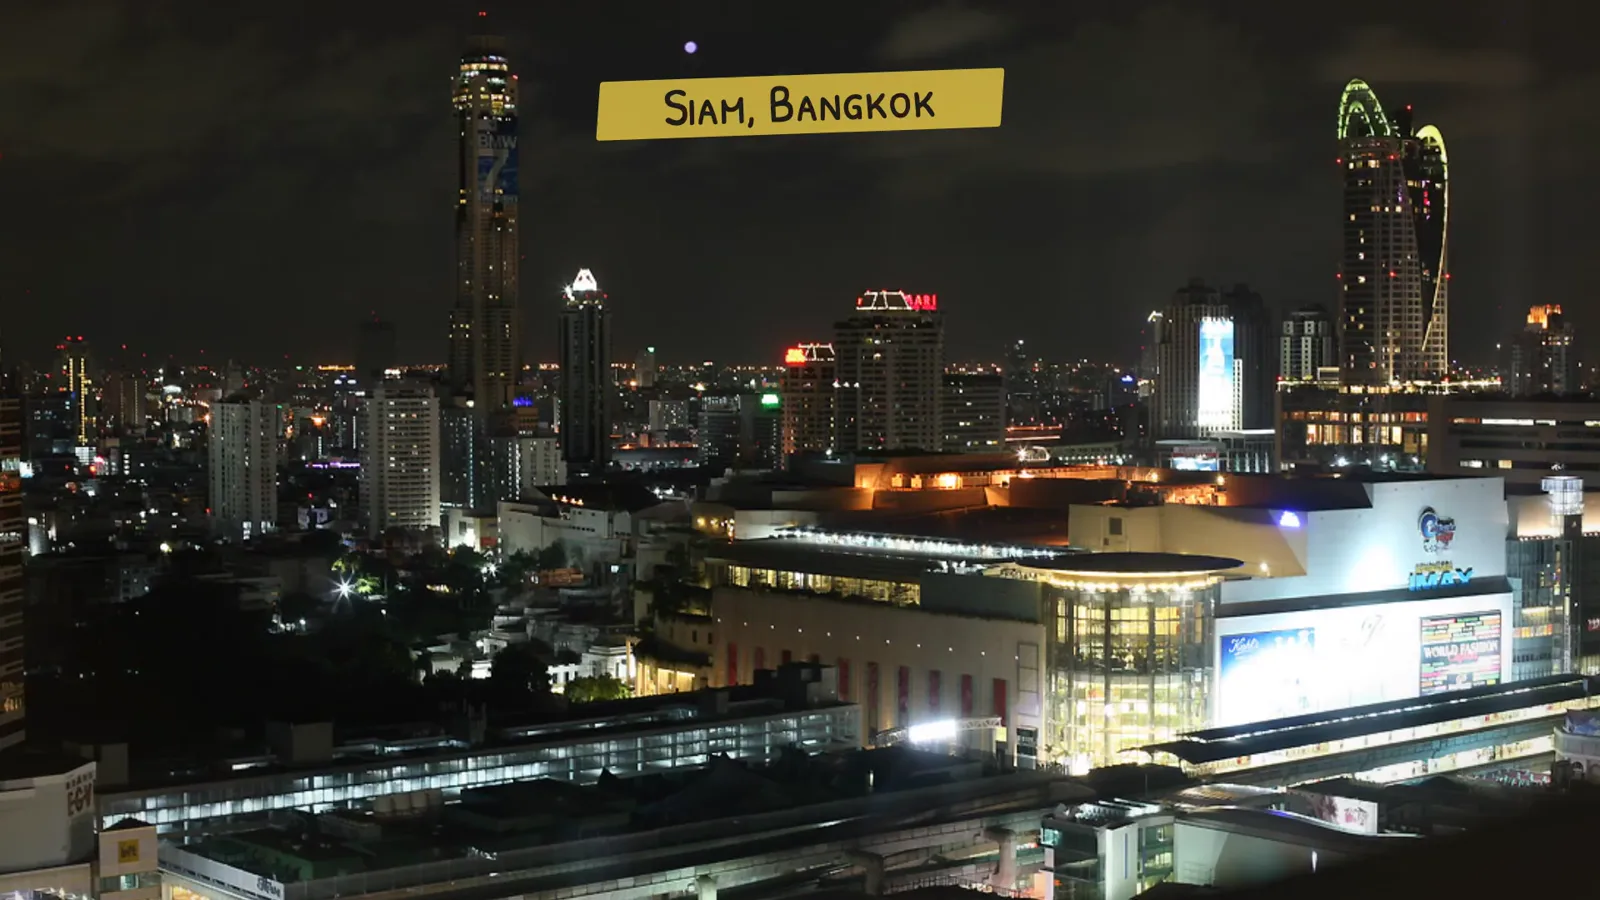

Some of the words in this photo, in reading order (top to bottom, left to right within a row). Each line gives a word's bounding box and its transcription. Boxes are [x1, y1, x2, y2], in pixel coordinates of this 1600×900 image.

[479, 134, 518, 150] BMW
[1408, 566, 1474, 591] IMAX
[1422, 642, 1459, 660] WORLD
[1460, 639, 1499, 656] FASHION
